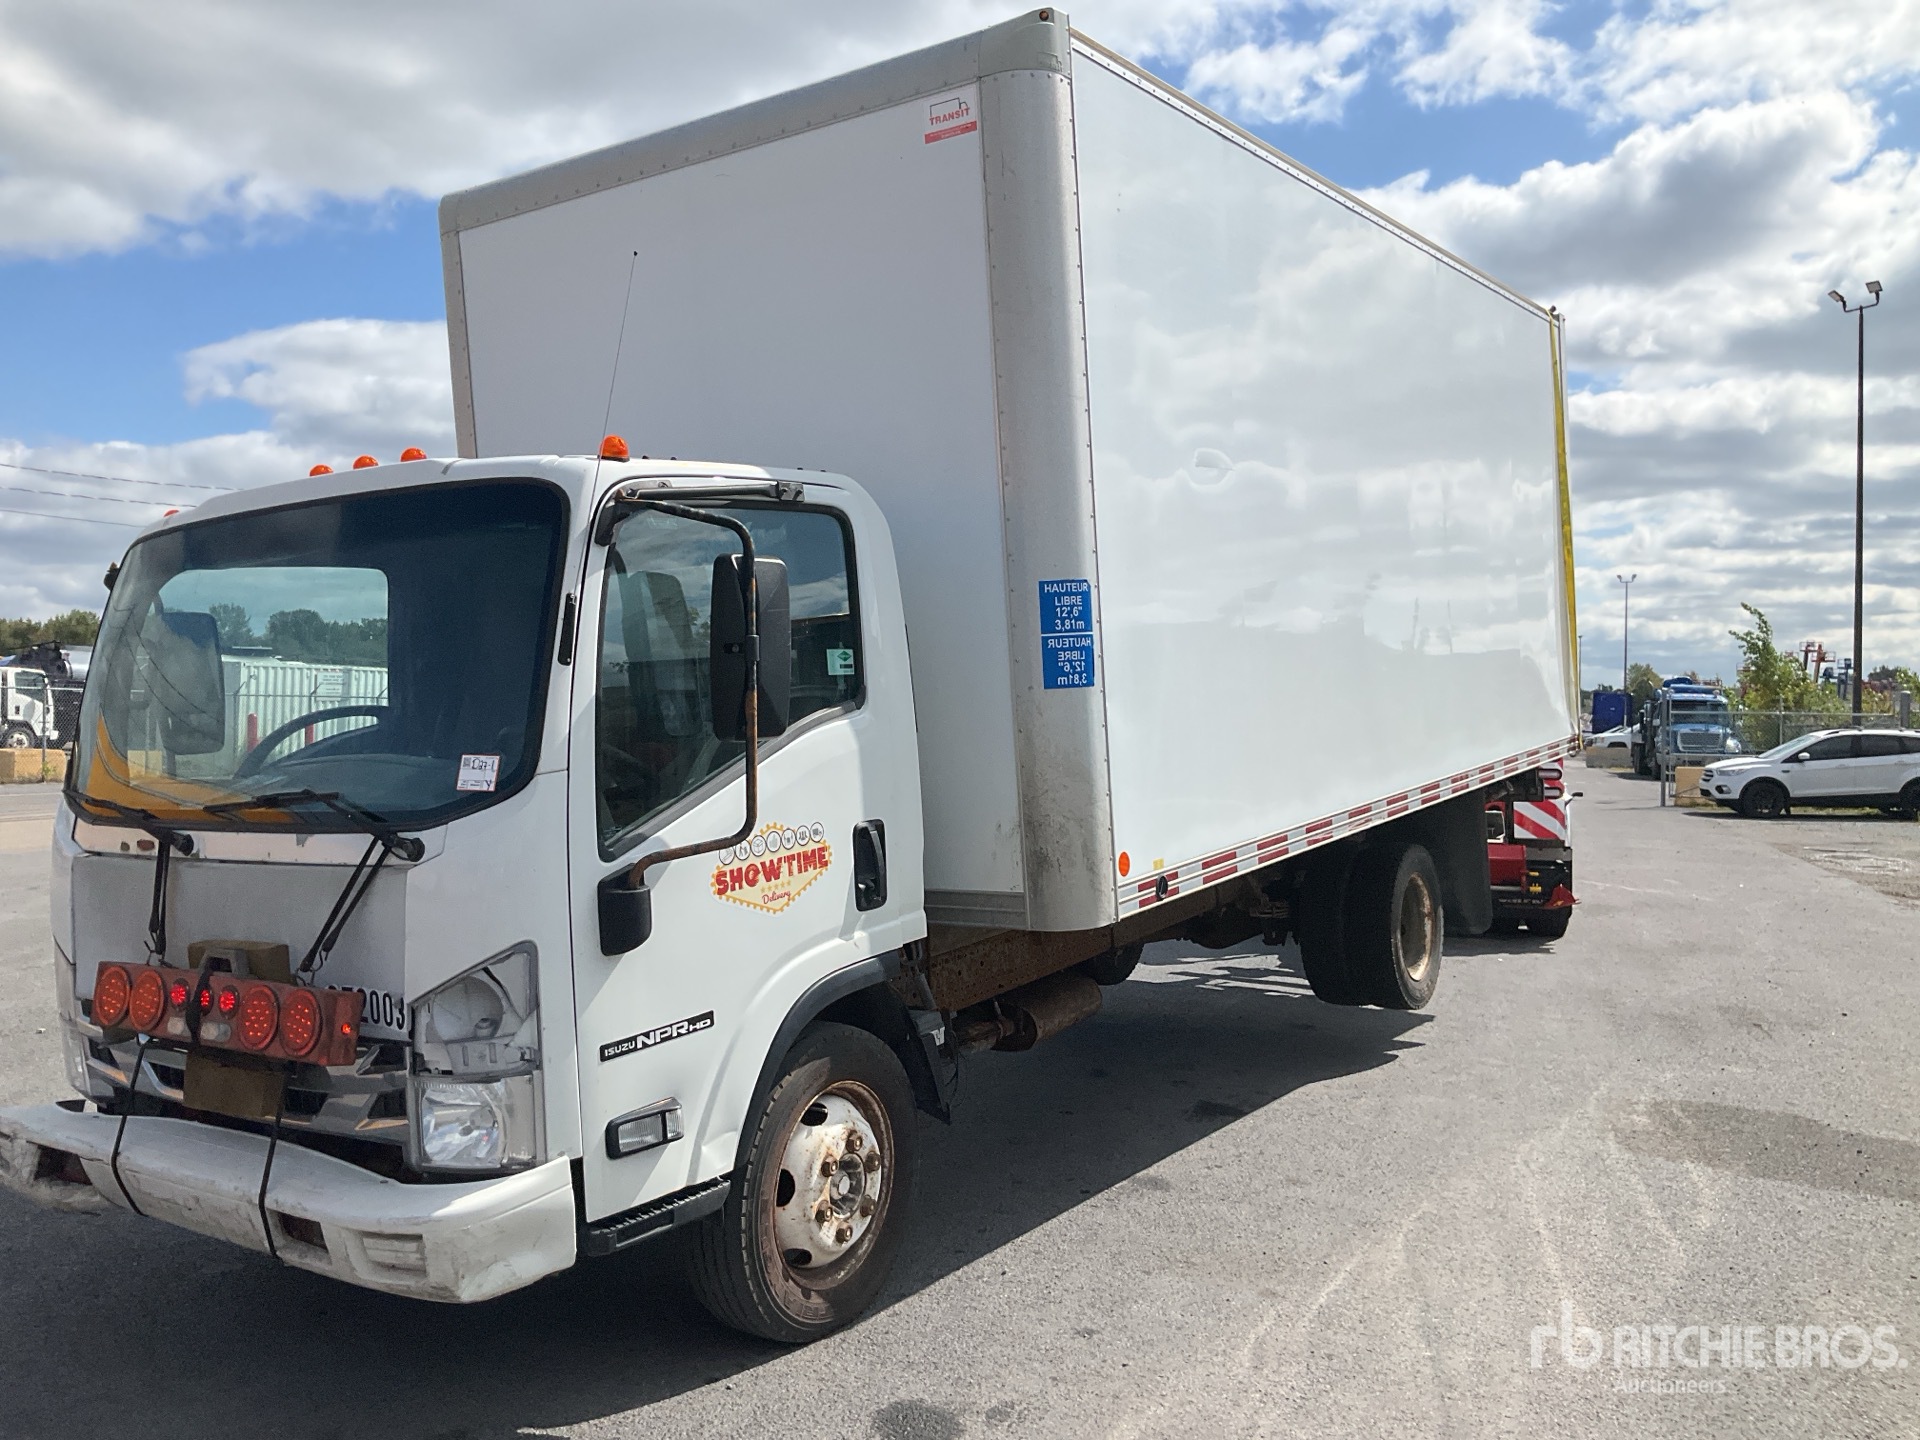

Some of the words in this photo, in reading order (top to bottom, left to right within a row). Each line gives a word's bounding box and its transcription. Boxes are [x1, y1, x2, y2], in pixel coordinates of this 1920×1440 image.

[929, 107, 970, 126] TRANSIT
[1044, 582, 1089, 593] HAUTEUR
[1054, 595, 1083, 606] LIBRE
[1054, 619, 1085, 631] 3,81m
[715, 845, 829, 896] SHOWTIME
[762, 890, 791, 905] Delivery
[604, 1040, 636, 1057] ISUZU
